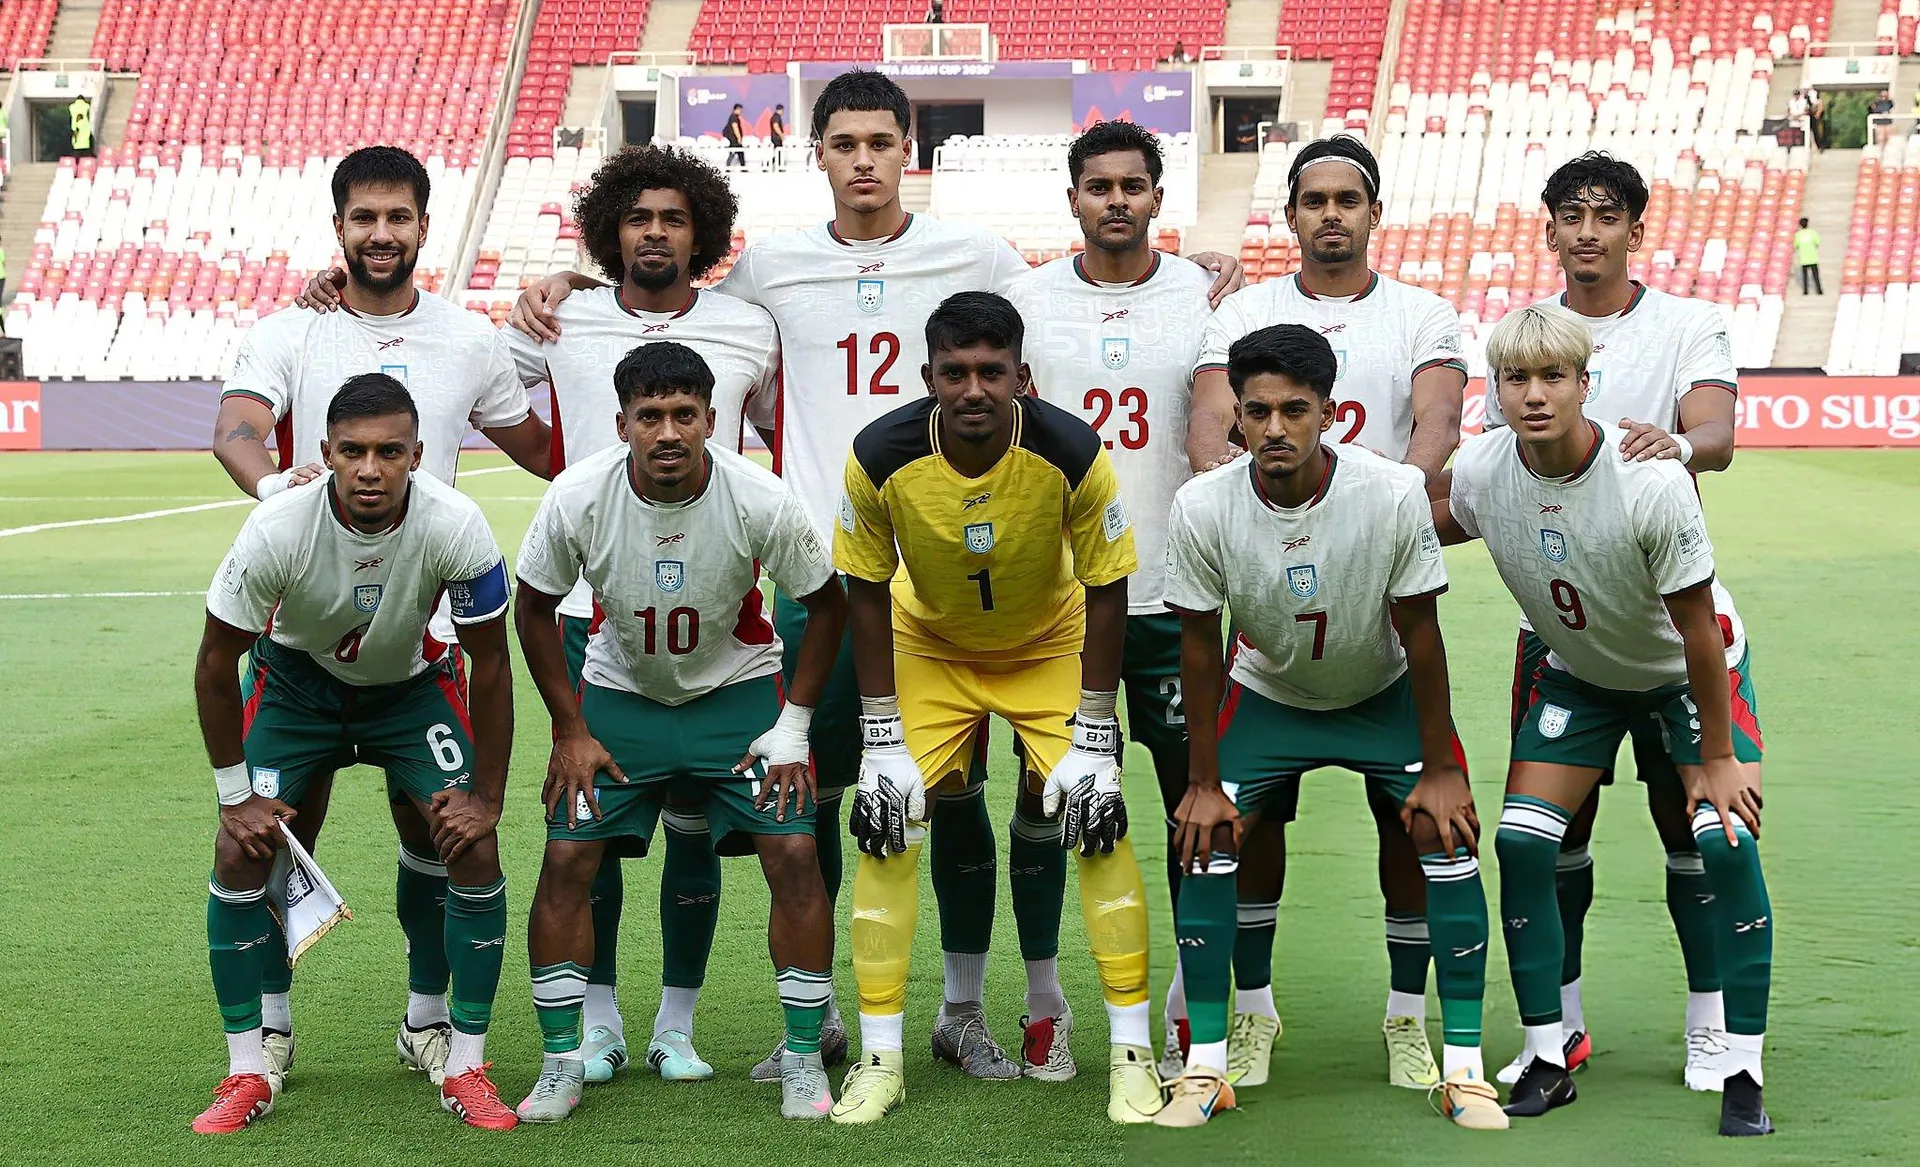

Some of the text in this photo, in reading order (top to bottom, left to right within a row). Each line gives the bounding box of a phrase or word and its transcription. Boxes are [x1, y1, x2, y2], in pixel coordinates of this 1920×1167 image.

[939, 65, 962, 75] CUP
[837, 332, 901, 395] 12
[1084, 387, 1149, 450] 23
[967, 568, 994, 611] 1
[1549, 578, 1587, 631] 9
[633, 606, 699, 656] 10
[1295, 611, 1328, 660] 7
[425, 723, 464, 771] 6
[869, 727, 893, 738] KB
[1085, 731, 1110, 743] KB
